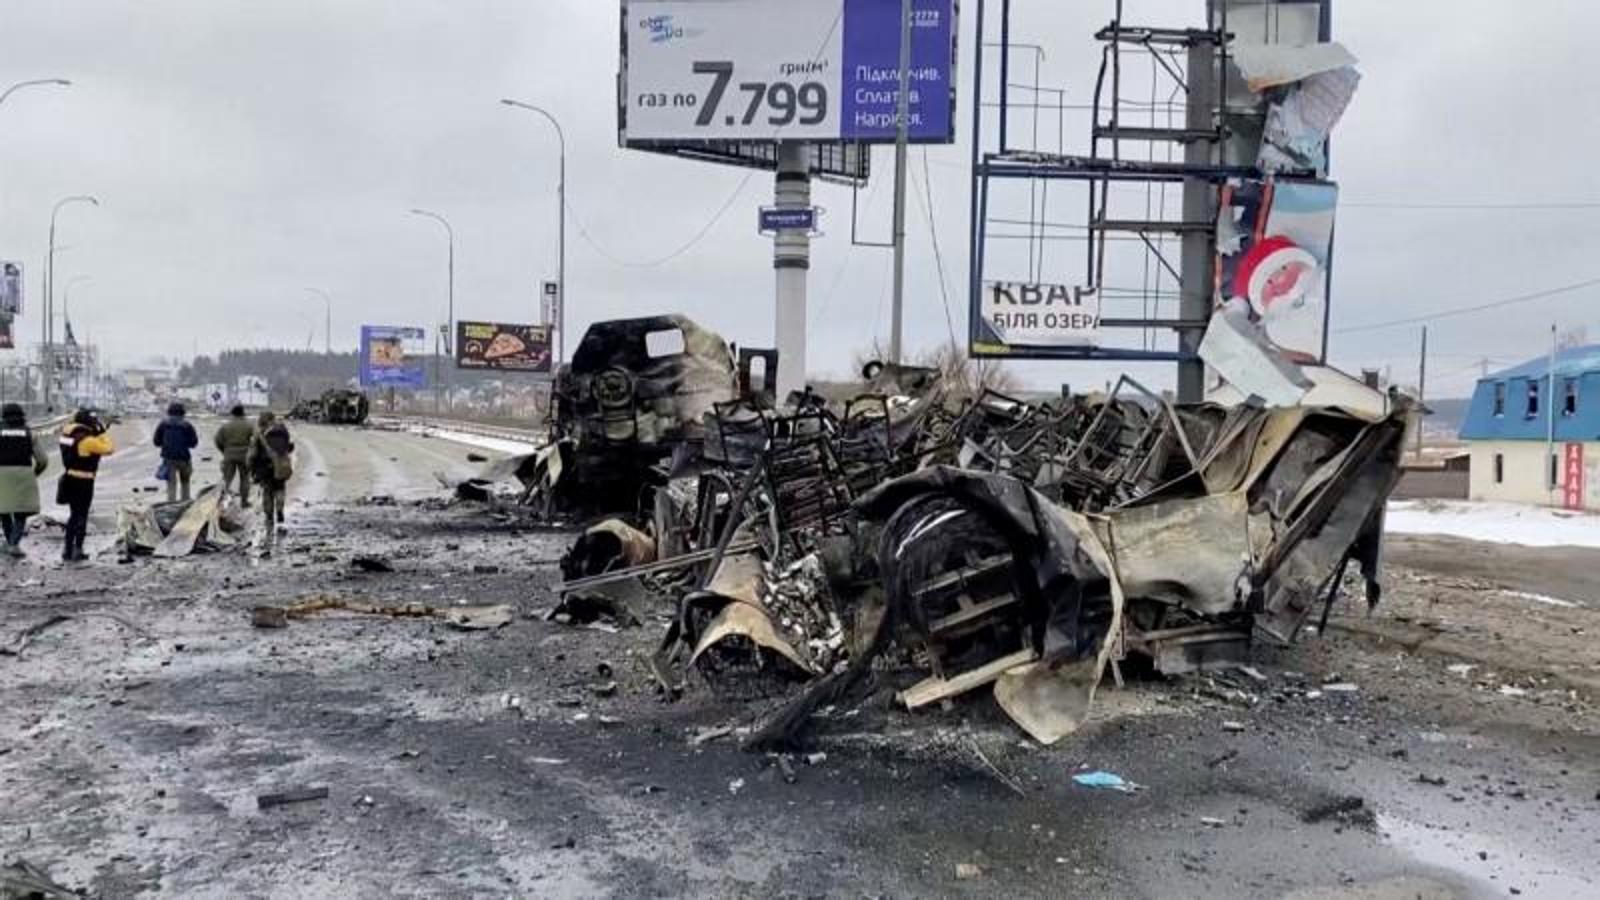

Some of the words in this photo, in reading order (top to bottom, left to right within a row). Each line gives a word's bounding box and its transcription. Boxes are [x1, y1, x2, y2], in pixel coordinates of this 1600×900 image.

[638, 92, 667, 107] газ
[673, 93, 697, 107] по
[692, 61, 828, 126] 7.799
[993, 283, 1097, 306] КВАР
[993, 312, 1039, 329] БІЛЯ
